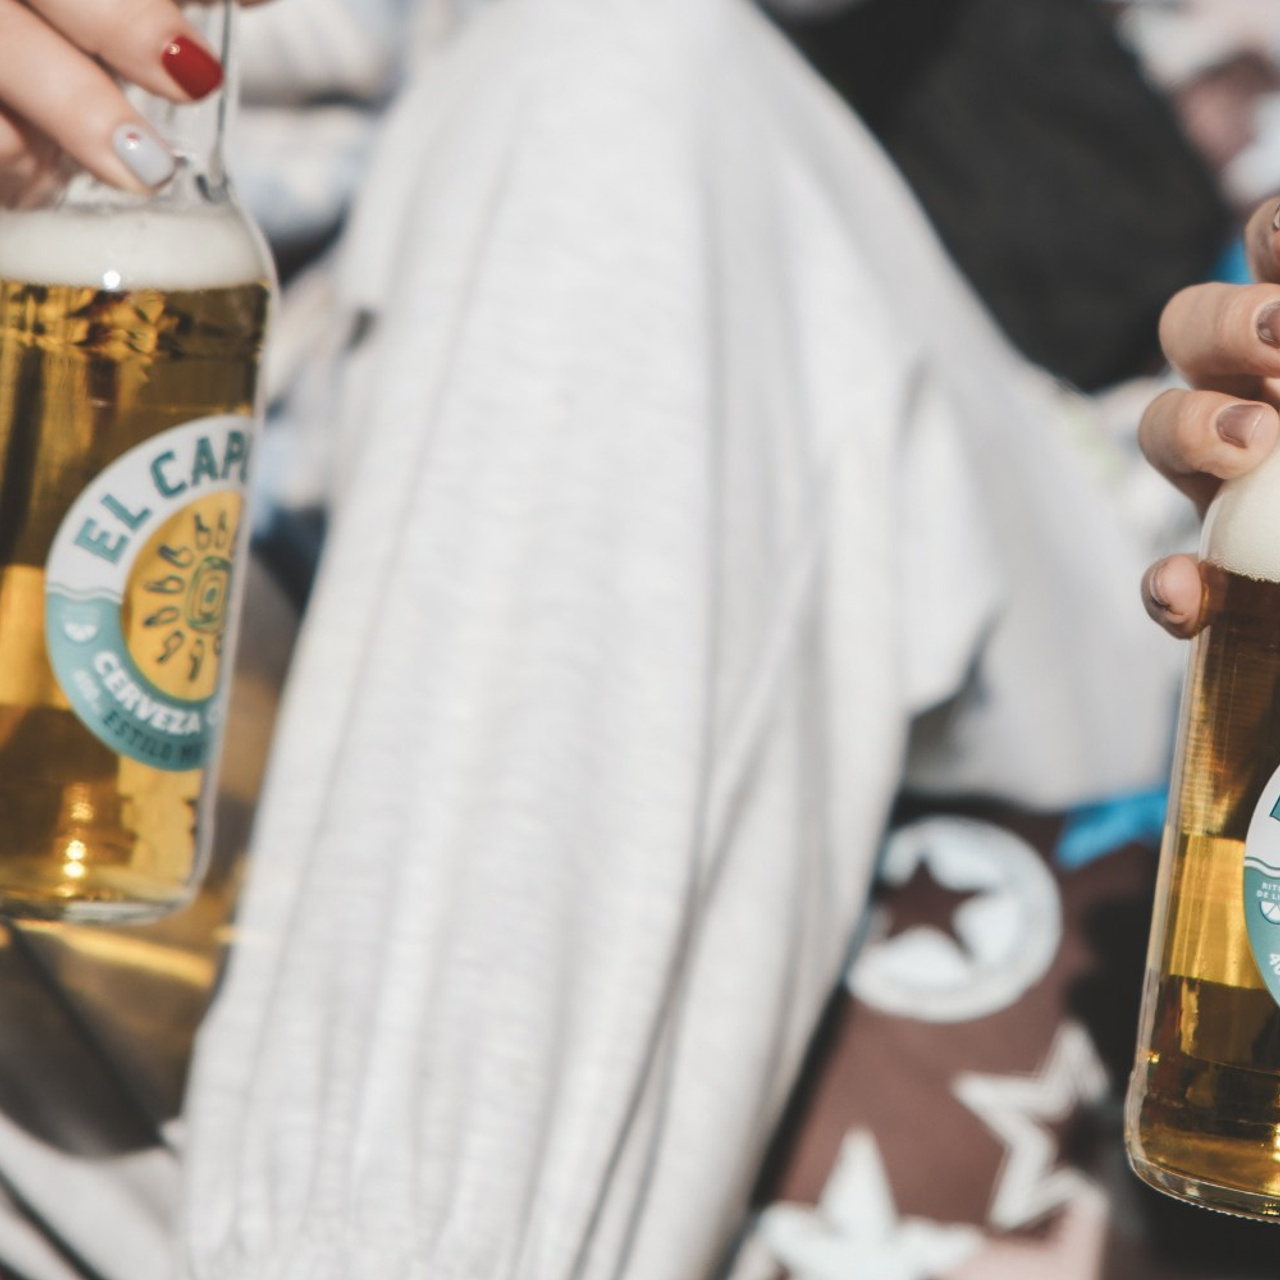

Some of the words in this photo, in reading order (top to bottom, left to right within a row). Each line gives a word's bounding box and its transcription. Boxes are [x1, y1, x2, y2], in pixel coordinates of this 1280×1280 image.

[73, 493, 150, 567] EL
[93, 648, 201, 737] CERVEZA
[103, 709, 173, 761] ESTILO
[1256, 889, 1269, 900] DE
